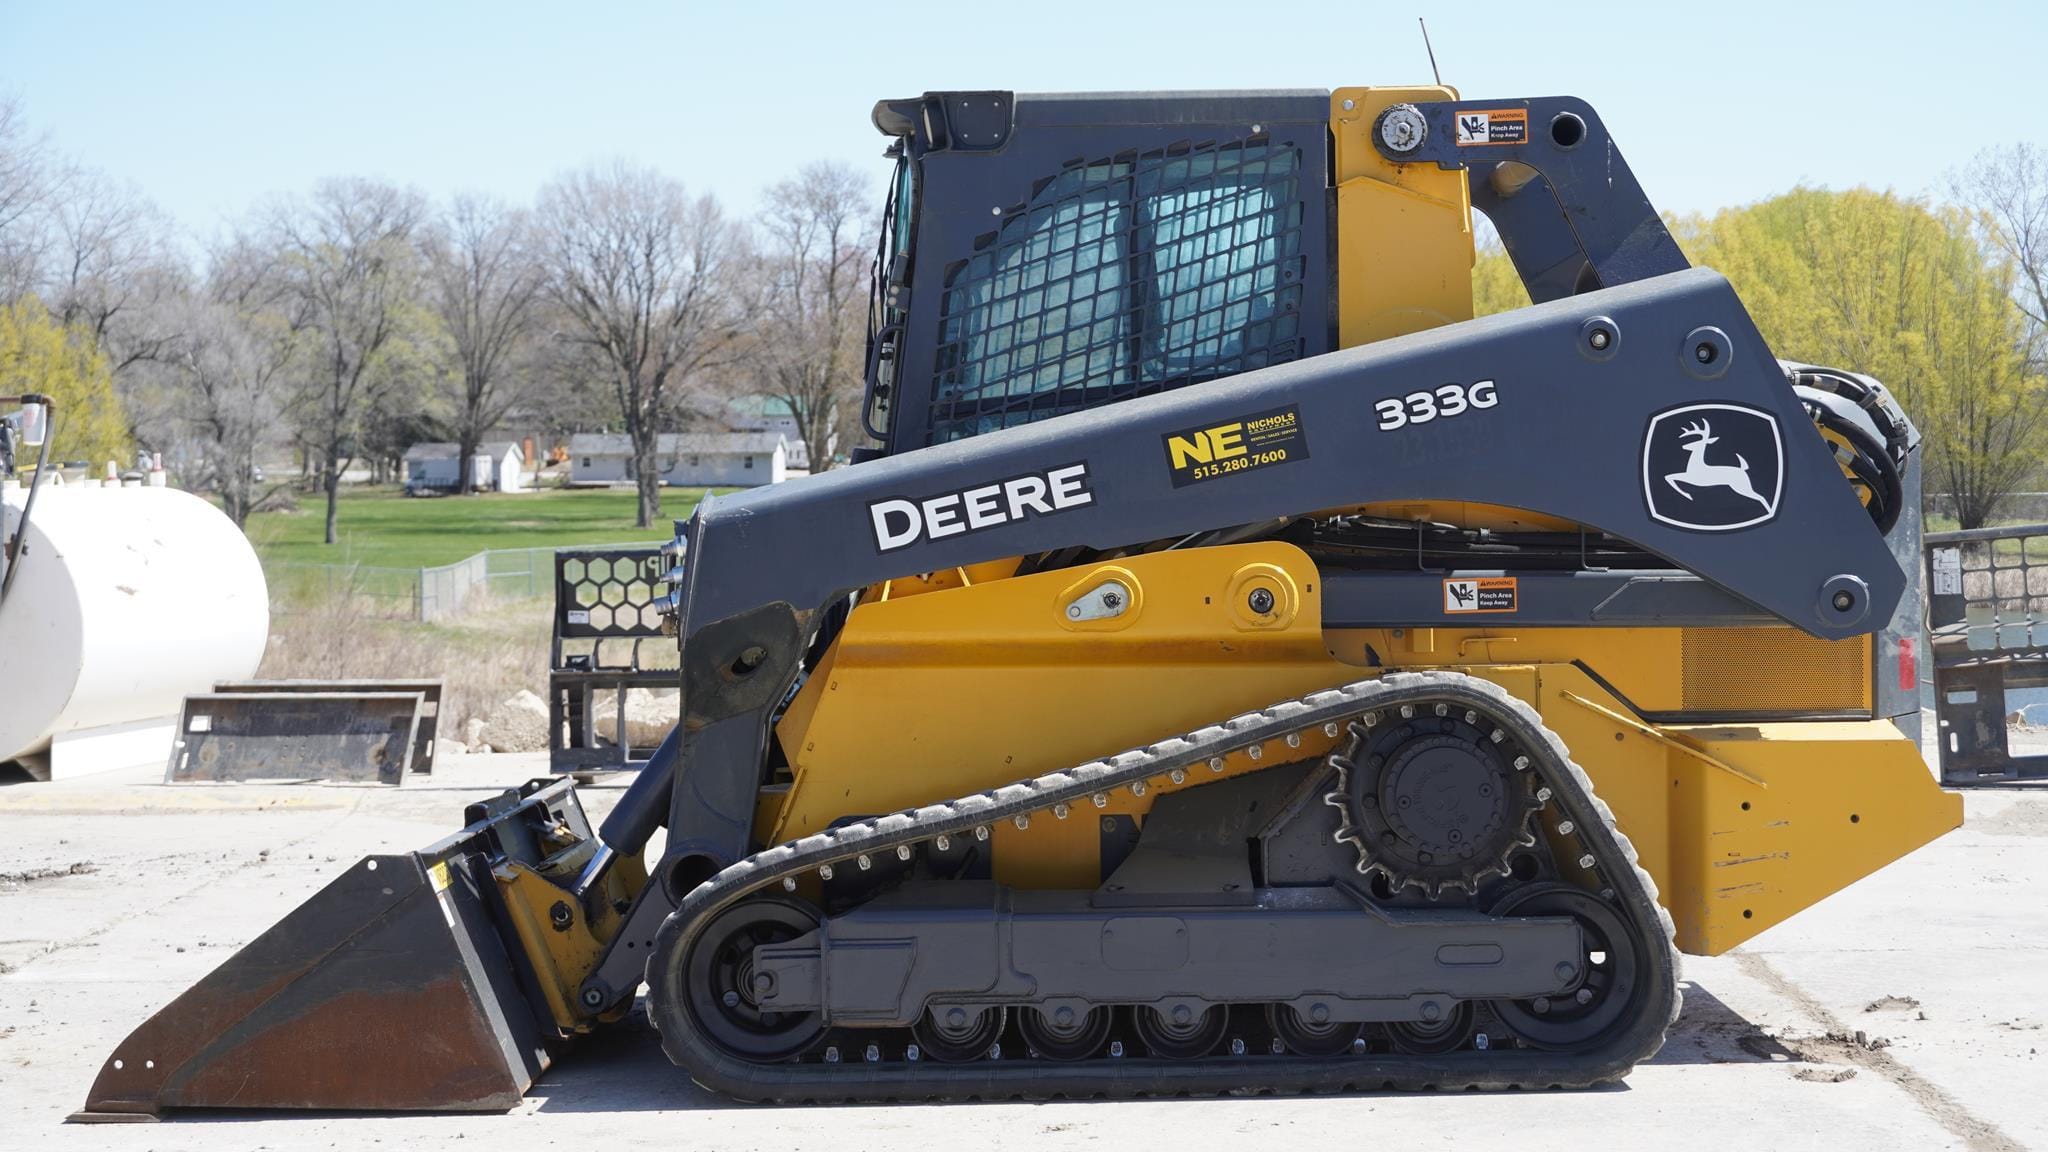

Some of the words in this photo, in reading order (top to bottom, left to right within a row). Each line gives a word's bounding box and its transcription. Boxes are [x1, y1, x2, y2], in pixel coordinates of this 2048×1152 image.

[1247, 412, 1295, 430] NICHOLS
[1375, 380, 1498, 430] 333G
[1168, 422, 1247, 470] NE
[1194, 449, 1287, 479] 515.280.7600
[870, 464, 1092, 551] DEERE
